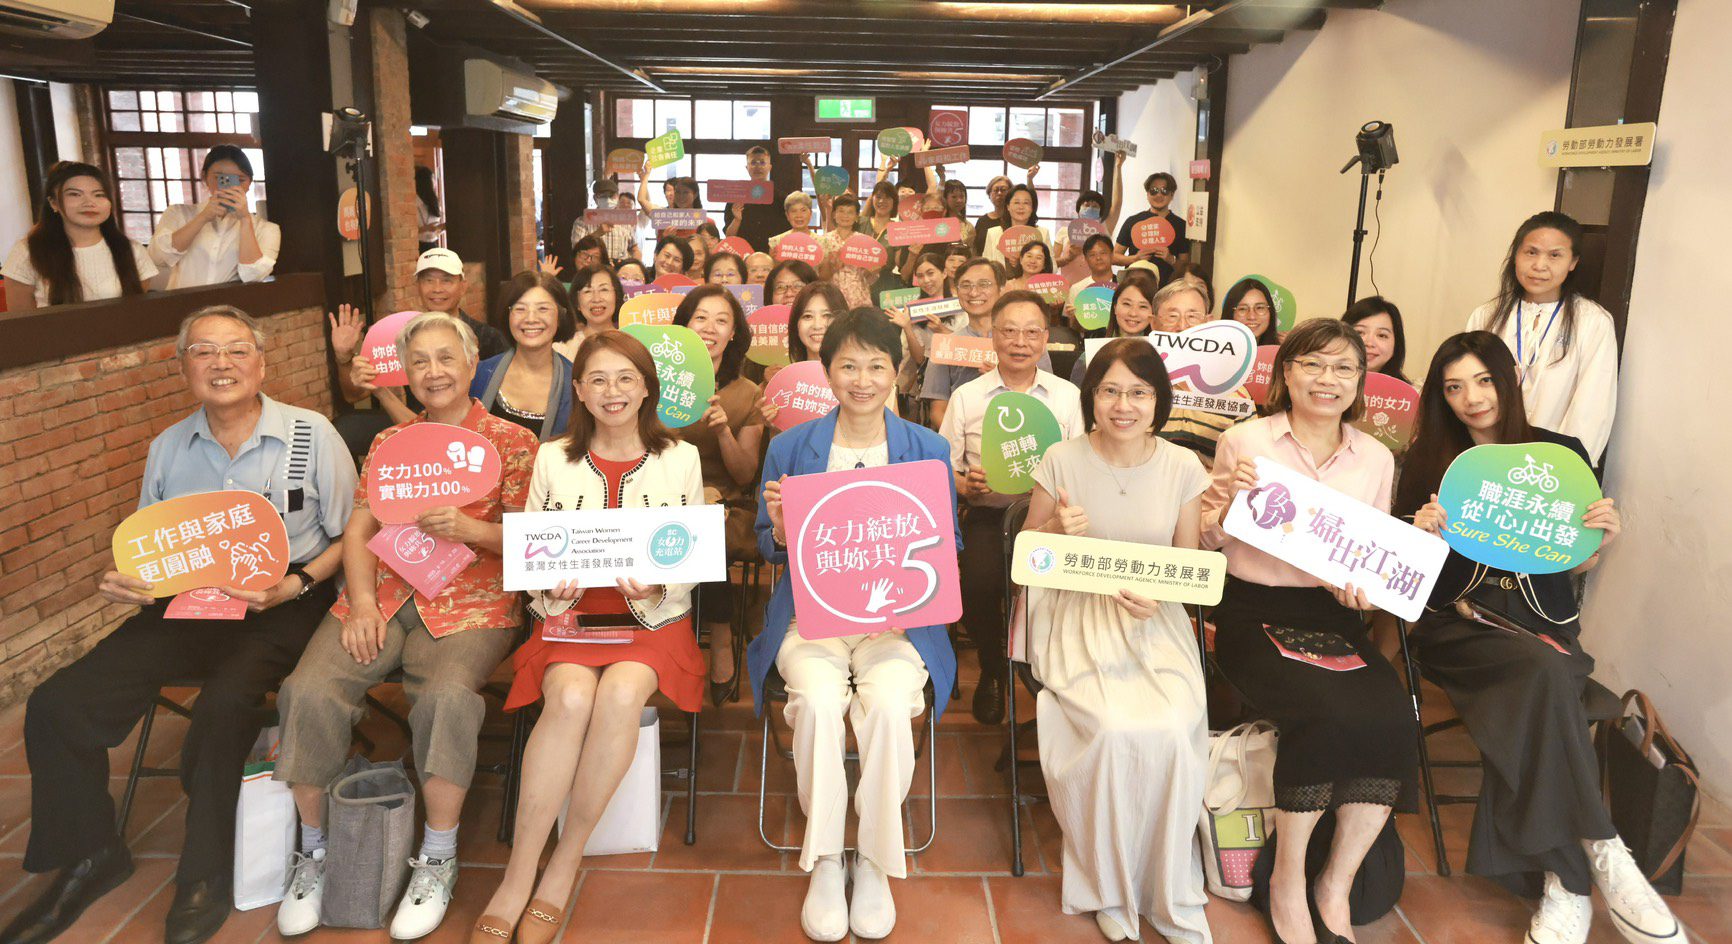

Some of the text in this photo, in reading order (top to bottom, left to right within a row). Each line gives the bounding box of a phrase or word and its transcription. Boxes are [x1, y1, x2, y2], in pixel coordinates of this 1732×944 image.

[1155, 333, 1236, 356] TWCDA
[795, 380, 838, 402] 妳的精
[665, 405, 691, 422] Can
[792, 396, 835, 416] 由妳定
[1000, 434, 1038, 460] 翻轉
[1007, 455, 1041, 479] 未來
[1478, 480, 1576, 524] 職涯永續
[128, 503, 257, 561] 工作與家庭
[811, 512, 922, 549] 女力綻放
[1460, 498, 1580, 548] 從「心」出發
[525, 532, 563, 541] TWCDA
[592, 536, 633, 545] Development
[1448, 521, 1572, 565] Sure She Can
[136, 543, 217, 583] 更圓融
[525, 556, 635, 572] 臺灣女性生涯發展協會
[1063, 552, 1211, 582] 勞動部勞動力發展署
[1305, 508, 1427, 601] 婦出江湖
[816, 535, 943, 615] 與妳共 5
[1062, 568, 1096, 578] WORKFORCE
[1096, 572, 1134, 582] DEVELOPMENT
[1158, 579, 1183, 587] MINISTRY
